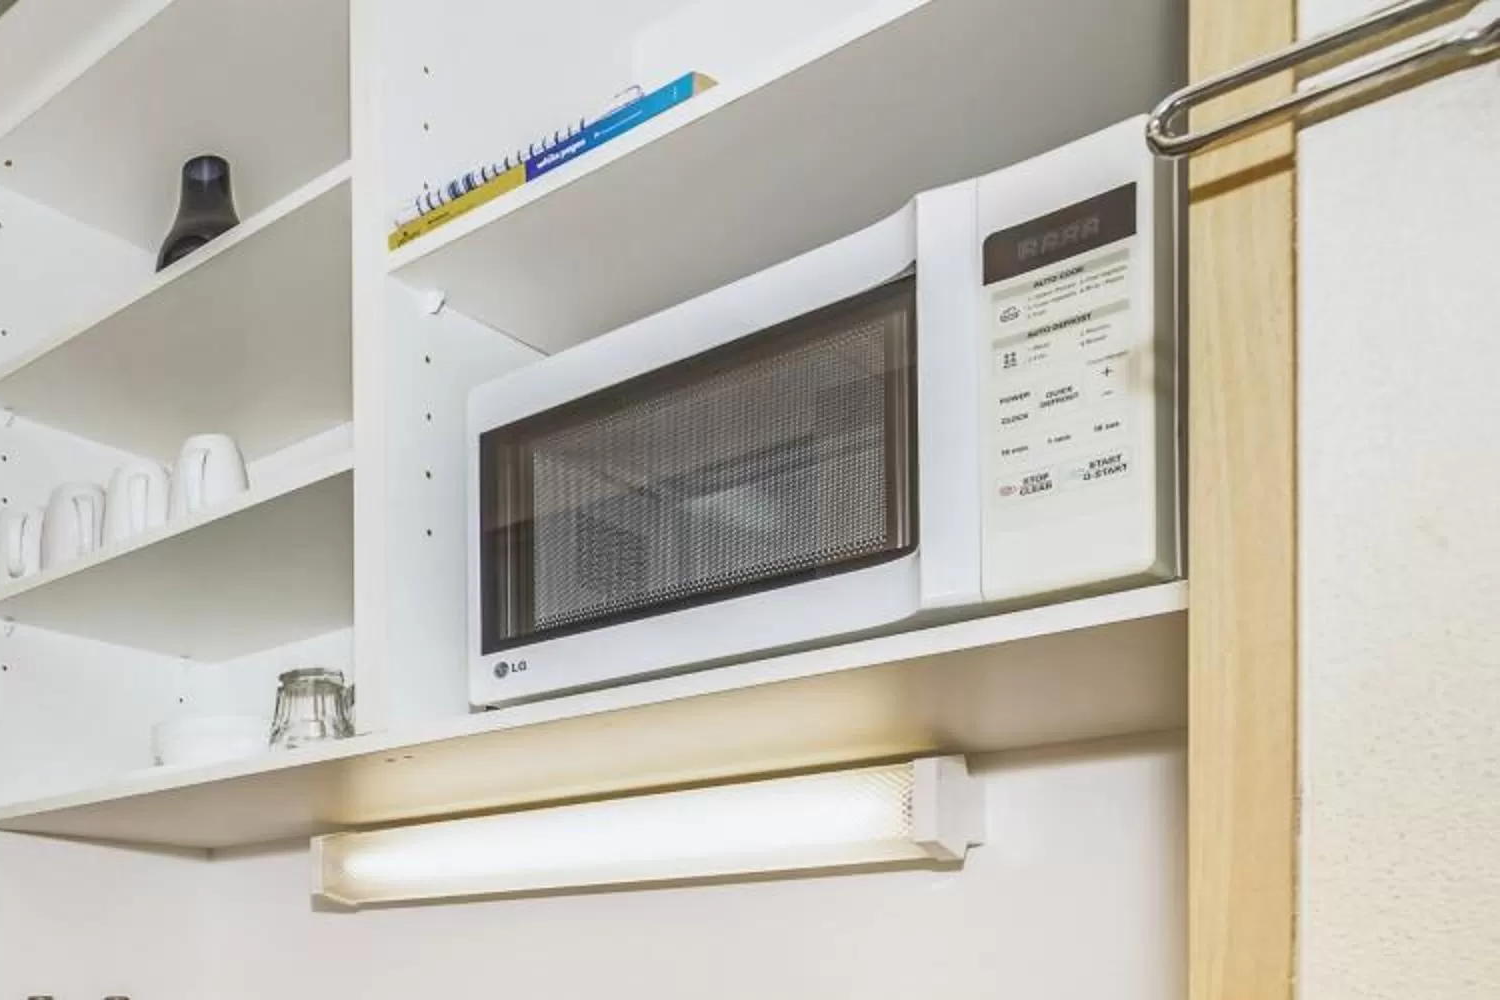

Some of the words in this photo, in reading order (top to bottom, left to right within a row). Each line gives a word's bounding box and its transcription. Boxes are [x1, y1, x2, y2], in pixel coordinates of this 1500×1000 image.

[1088, 453, 1122, 469] START
[1023, 472, 1049, 486] STOP
[1019, 480, 1052, 496] CLEAR
[511, 661, 527, 673] LG
